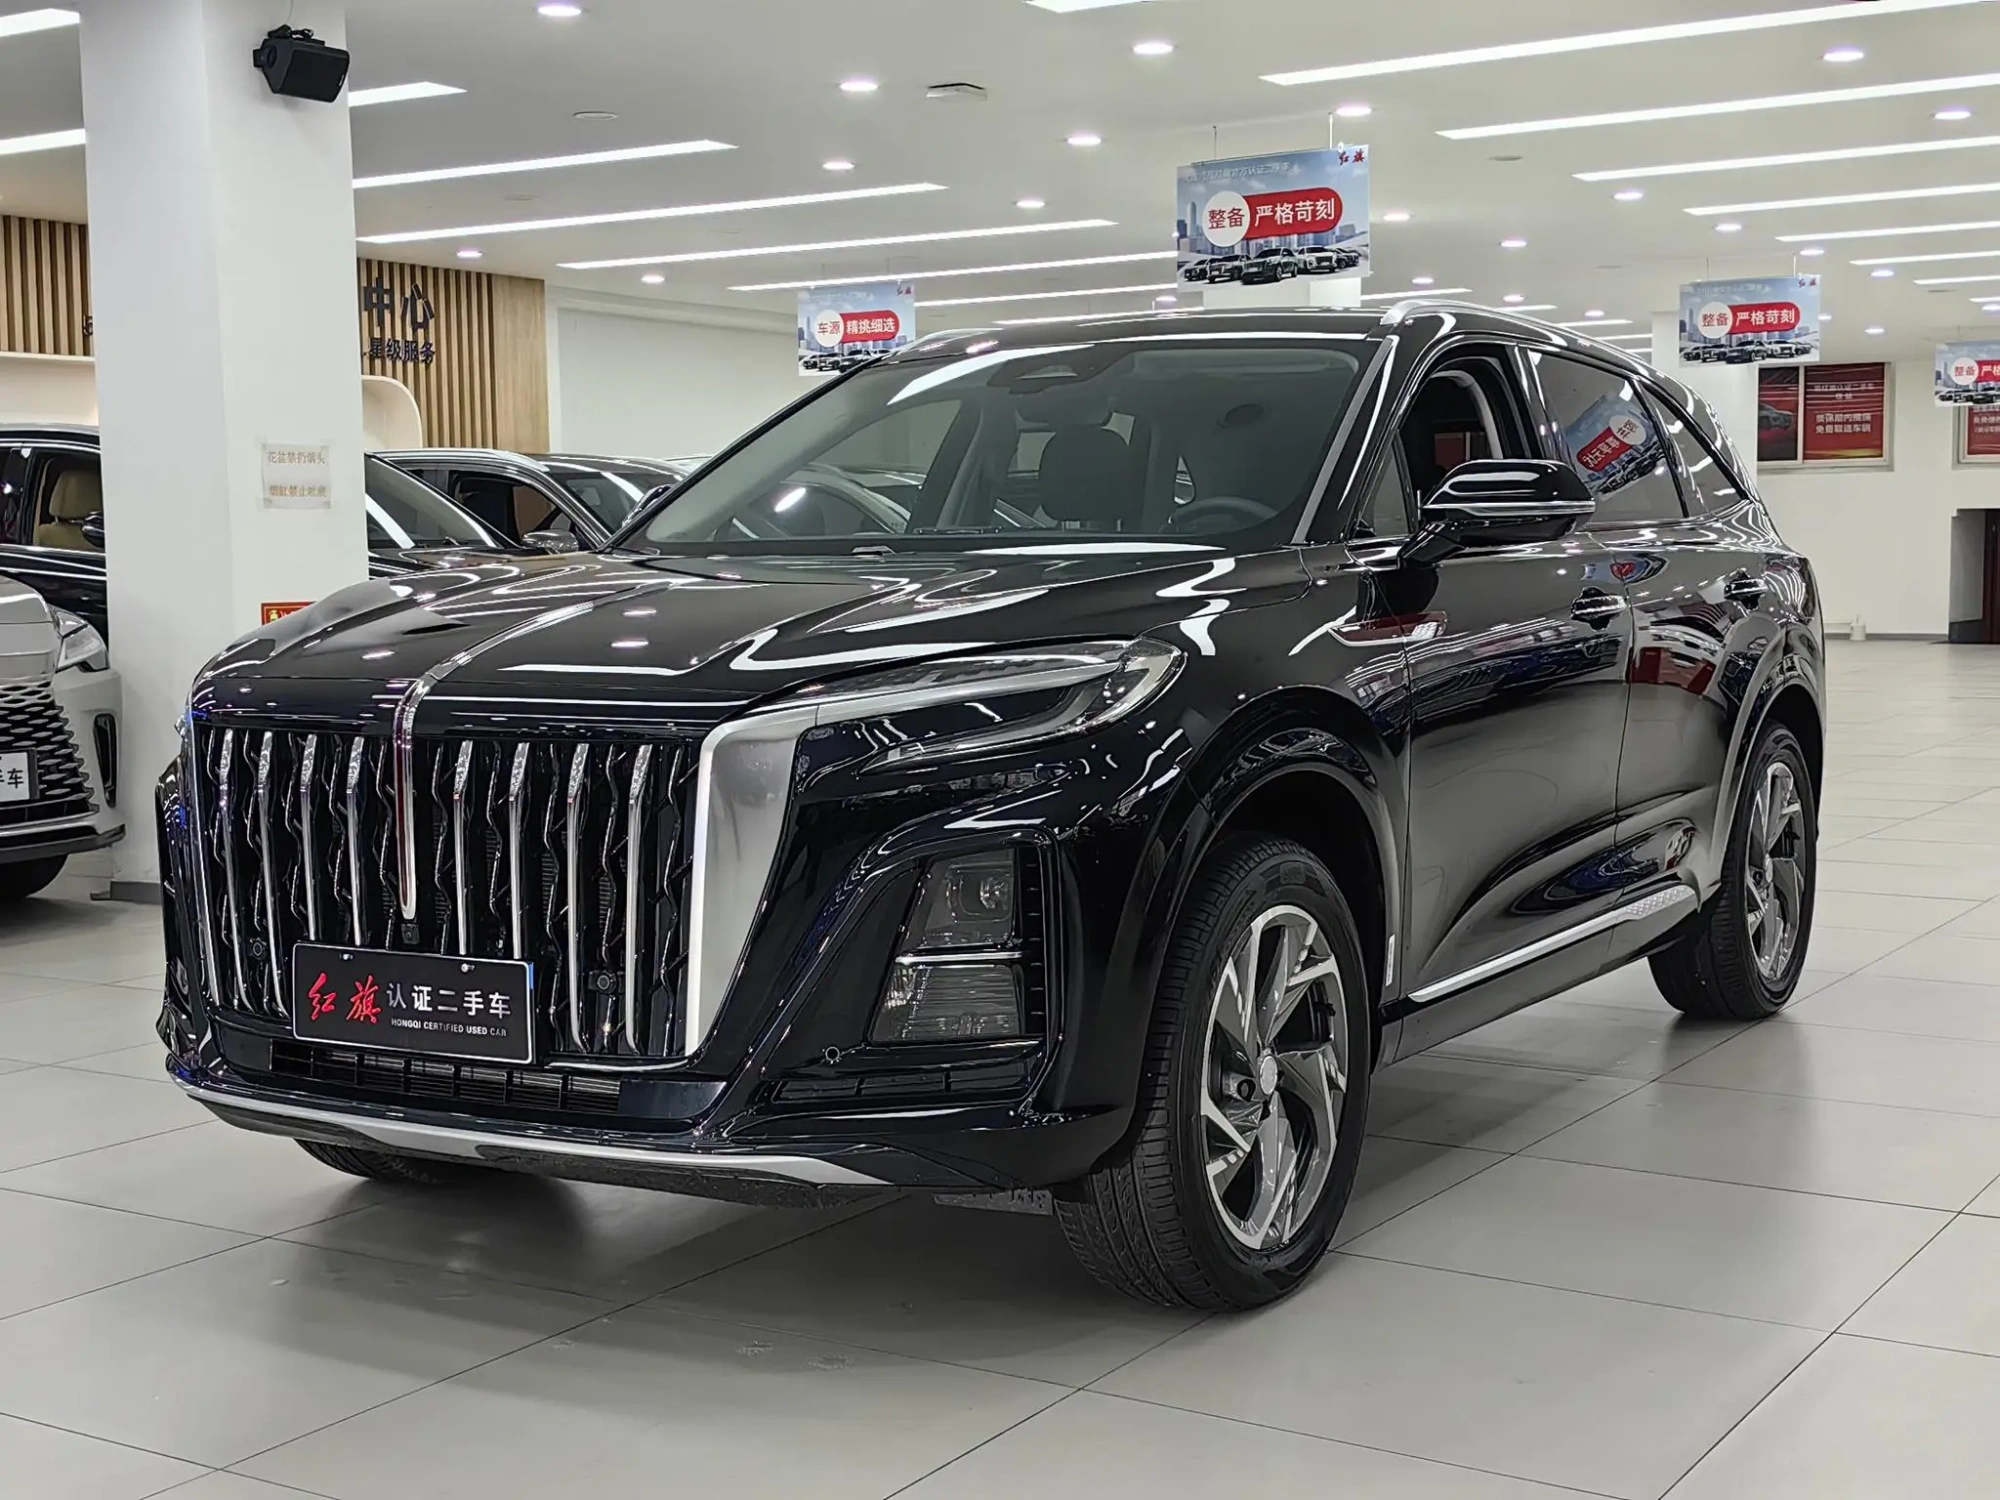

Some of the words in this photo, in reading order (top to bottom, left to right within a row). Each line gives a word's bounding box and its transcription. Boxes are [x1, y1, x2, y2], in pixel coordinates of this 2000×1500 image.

[1208, 207, 1245, 230] 整备
[1254, 198, 1336, 227] 严格苛刻
[363, 277, 435, 332] 中心
[817, 320, 841, 335] 车源
[846, 317, 896, 335] 精挑细选
[1702, 312, 1729, 327] 整备
[1735, 309, 1796, 327] 严格苛刻
[368, 337, 435, 363] 星级服务
[1955, 366, 1975, 377] 整备
[0, 768, 24, 789] 车
[307, 972, 382, 1023] 红旗
[386, 982, 512, 1019] 认证二手车
[391, 1018, 422, 1030] HONGQI
[423, 1021, 464, 1034] CERTIFIED
[466, 1025, 488, 1036] USED
[490, 1027, 507, 1037] CAR
